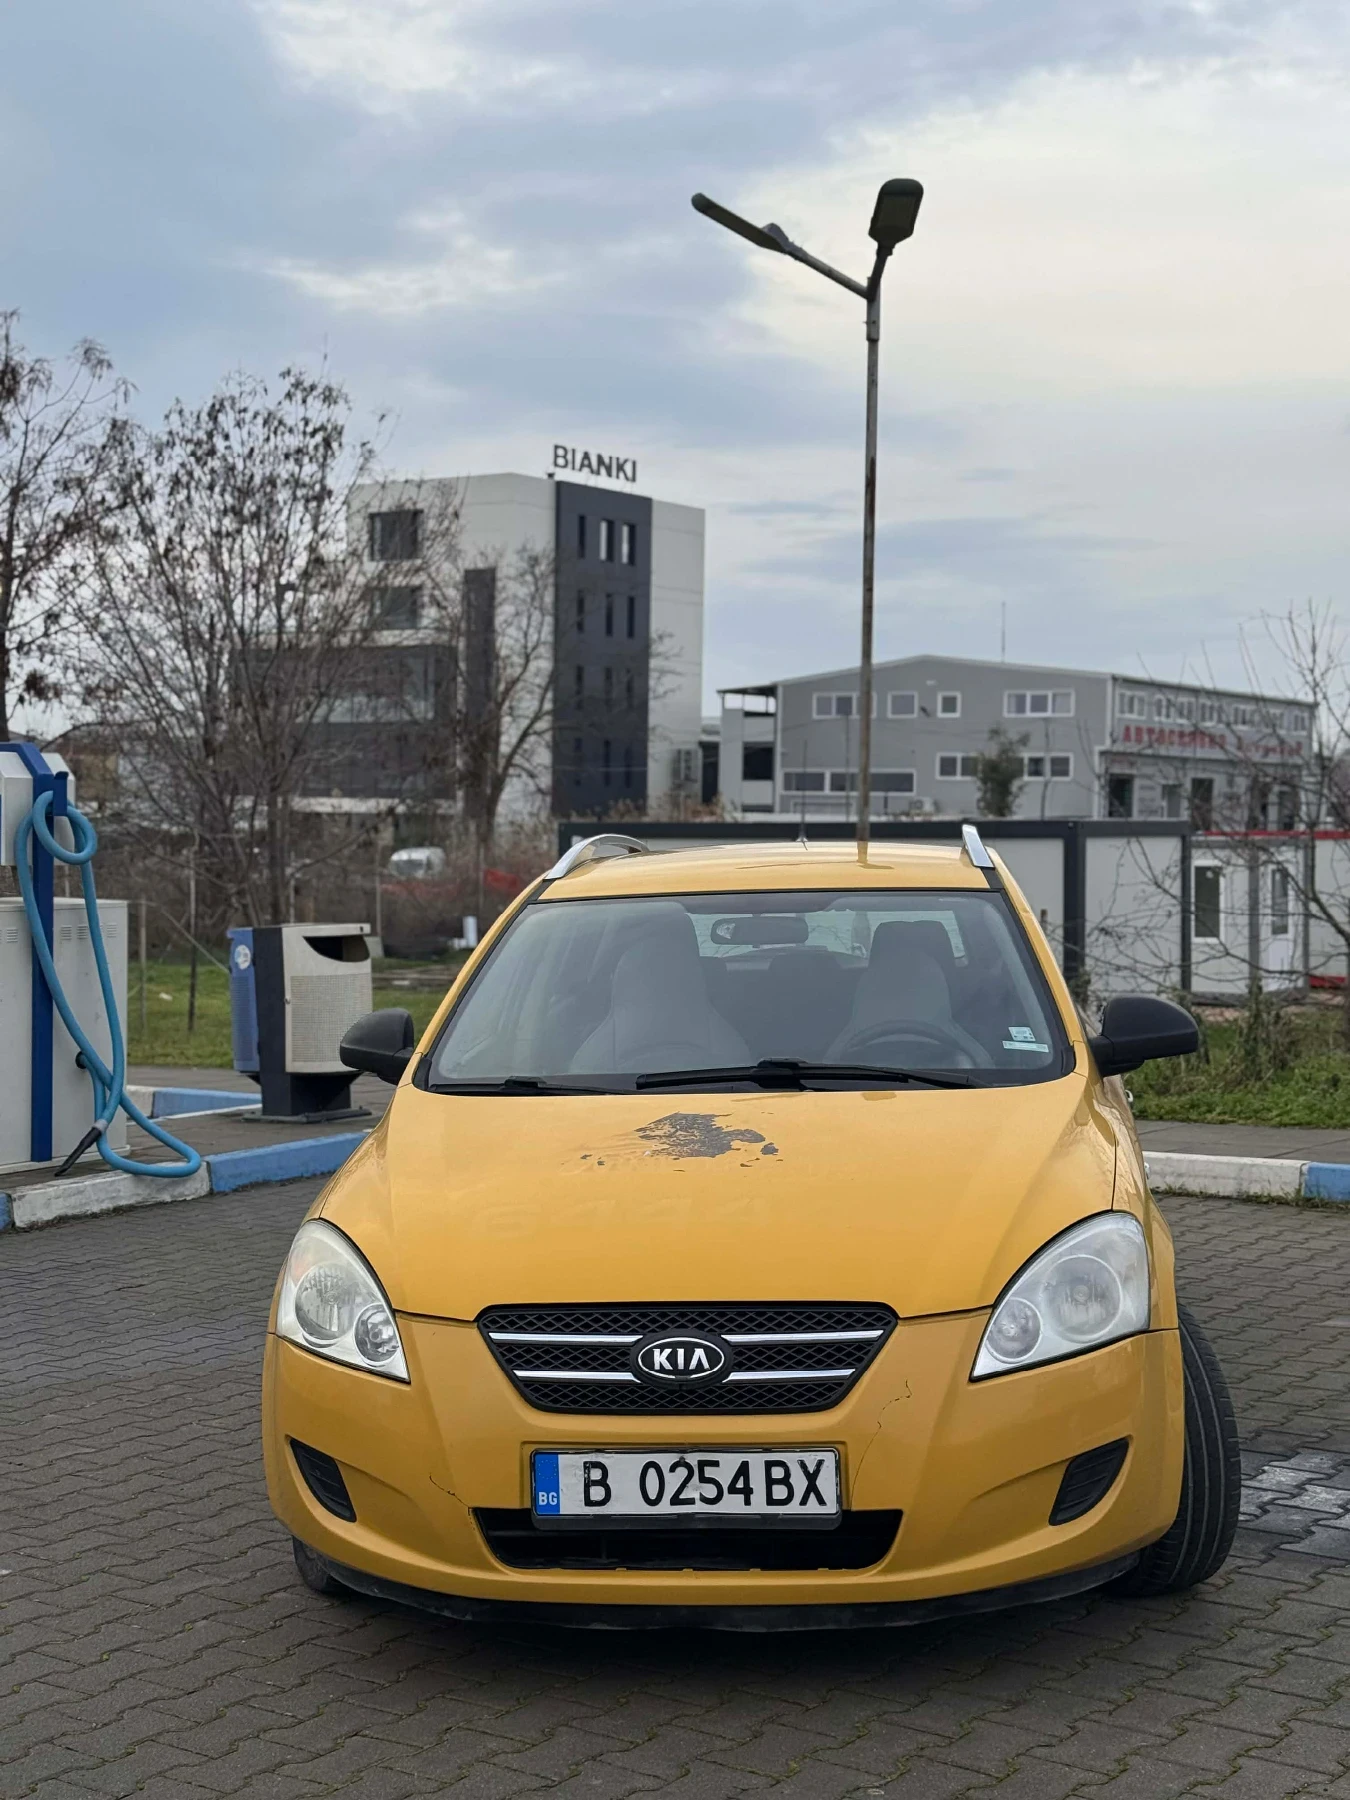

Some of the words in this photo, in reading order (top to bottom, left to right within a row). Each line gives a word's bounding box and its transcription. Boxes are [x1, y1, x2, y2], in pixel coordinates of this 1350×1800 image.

[553, 444, 636, 483] BIANKI
[652, 1347, 711, 1370] KIA
[538, 1491, 558, 1506] BG
[583, 1460, 612, 1507] B
